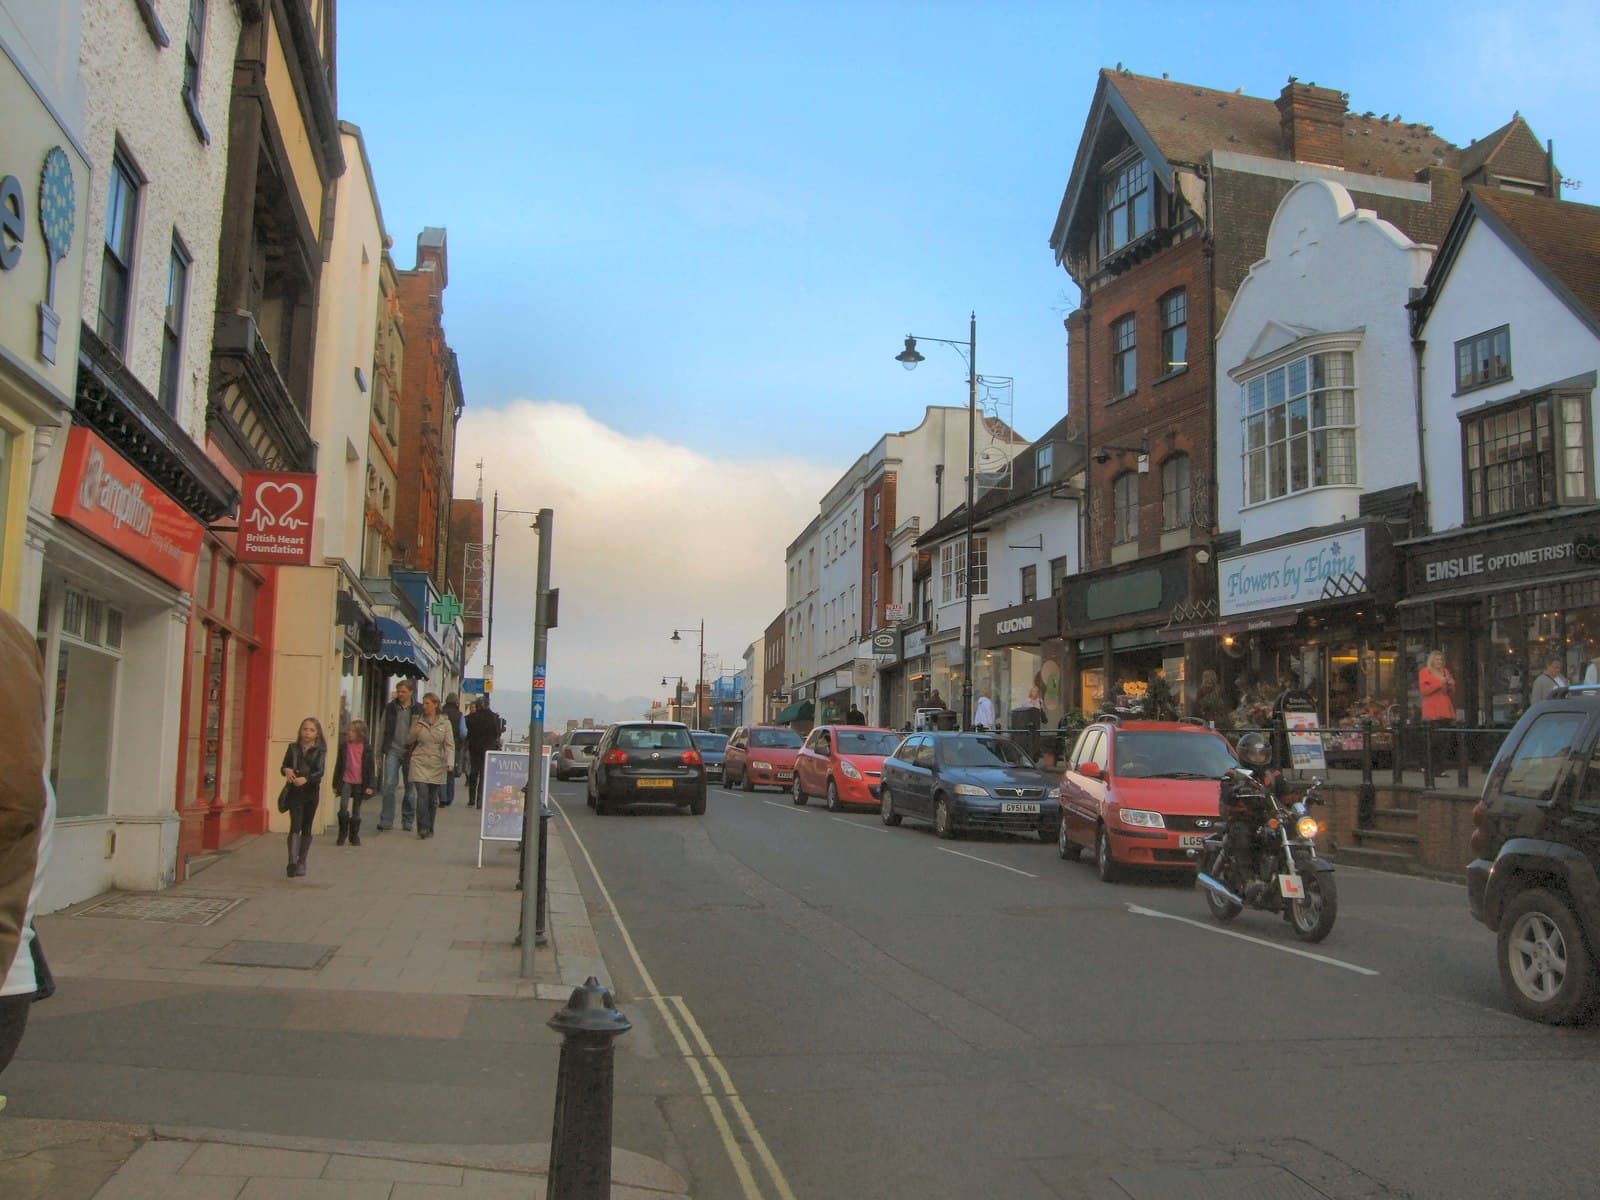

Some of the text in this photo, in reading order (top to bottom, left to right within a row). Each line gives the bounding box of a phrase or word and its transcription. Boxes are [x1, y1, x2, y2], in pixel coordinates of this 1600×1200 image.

[246, 533, 304, 545] British Heart
[245, 543, 304, 555] Foundation
[1227, 547, 1356, 600] Flowers by Elaine
[1426, 553, 1485, 583] EMSLIE
[996, 615, 1033, 635] KUONI
[533, 679, 545, 688] 22
[497, 759, 522, 771] WIN
